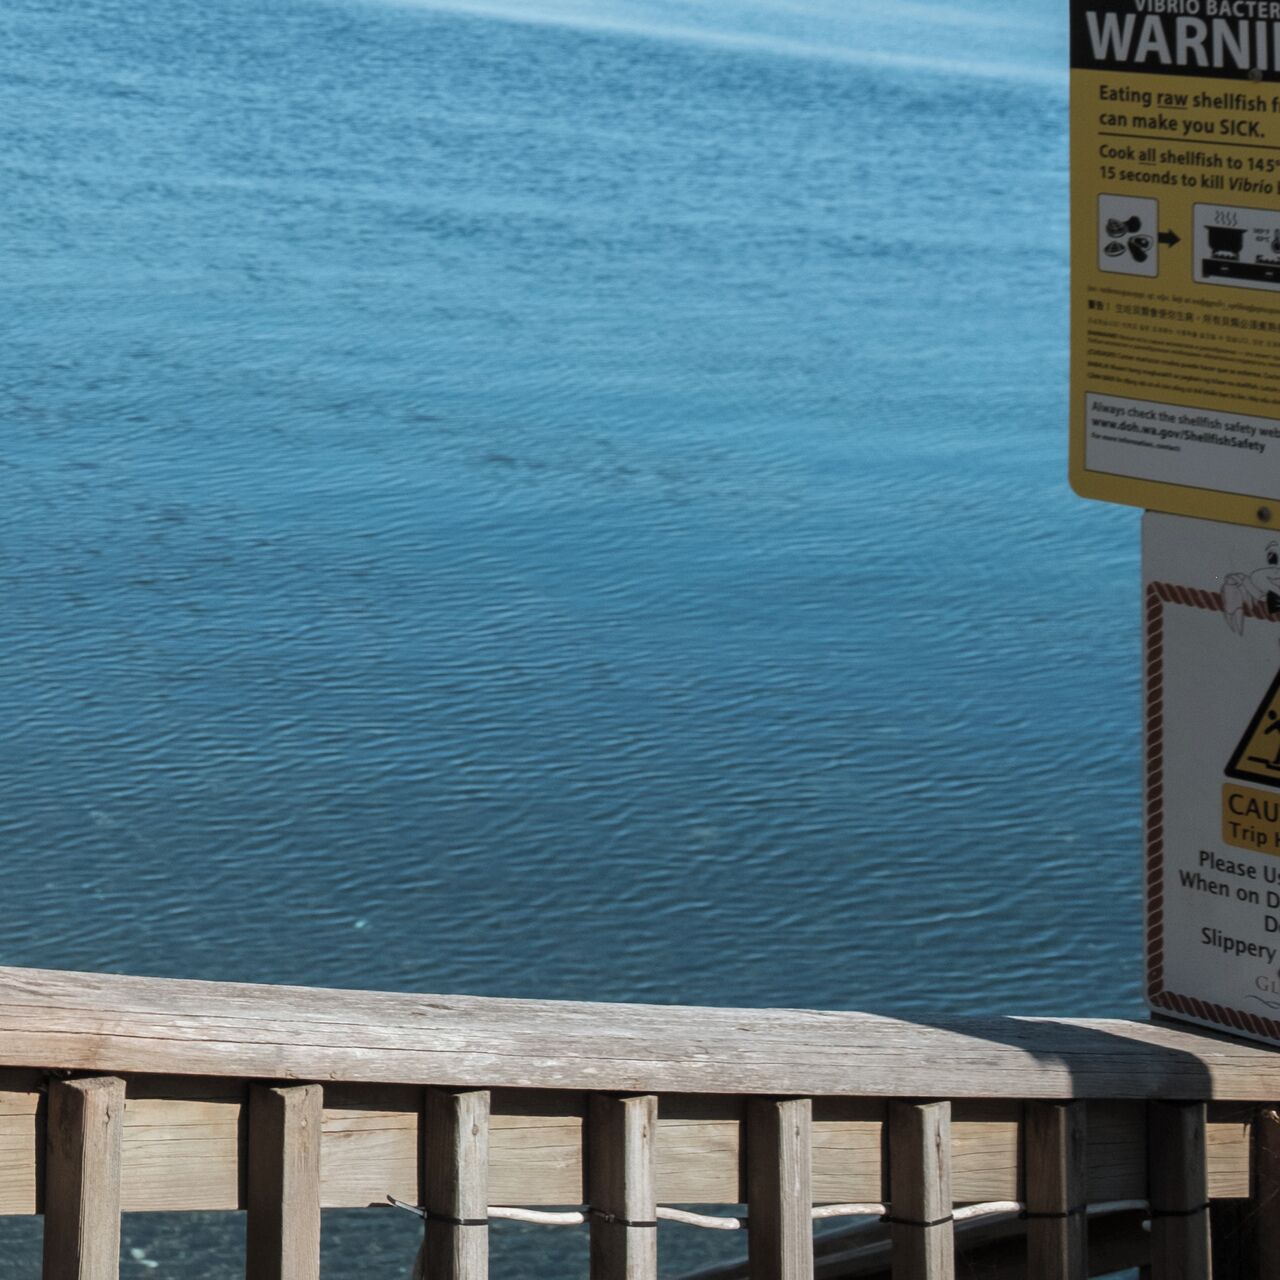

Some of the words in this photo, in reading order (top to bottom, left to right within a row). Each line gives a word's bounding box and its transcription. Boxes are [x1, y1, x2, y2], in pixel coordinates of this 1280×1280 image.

[1100, 85, 1151, 107] Eating
[1157, 93, 1188, 108] raw
[1193, 92, 1267, 112] shellfish
[1099, 113, 1127, 127] can
[1133, 114, 1177, 131] make
[1183, 121, 1214, 136] you
[1220, 119, 1265, 138] SICK.
[1100, 144, 1135, 160] Cook
[1139, 148, 1156, 162] all
[1160, 149, 1223, 168] shellfish
[1227, 156, 1243, 170] to
[1100, 166, 1116, 180] 15
[1120, 170, 1178, 185] seconds
[1181, 175, 1197, 188] to
[1201, 174, 1224, 190] kill
[1229, 177, 1273, 194] Vibrio
[1091, 401, 1125, 416] Always
[1127, 406, 1156, 421] check
[1159, 412, 1176, 424] the
[1178, 414, 1222, 430] shellfish
[1224, 421, 1256, 437] safety
[1228, 821, 1268, 847] Trip
[1199, 850, 1256, 879] Please
[1179, 869, 1230, 897] When
[1236, 888, 1259, 904] on
[1201, 927, 1277, 964] Slippery
